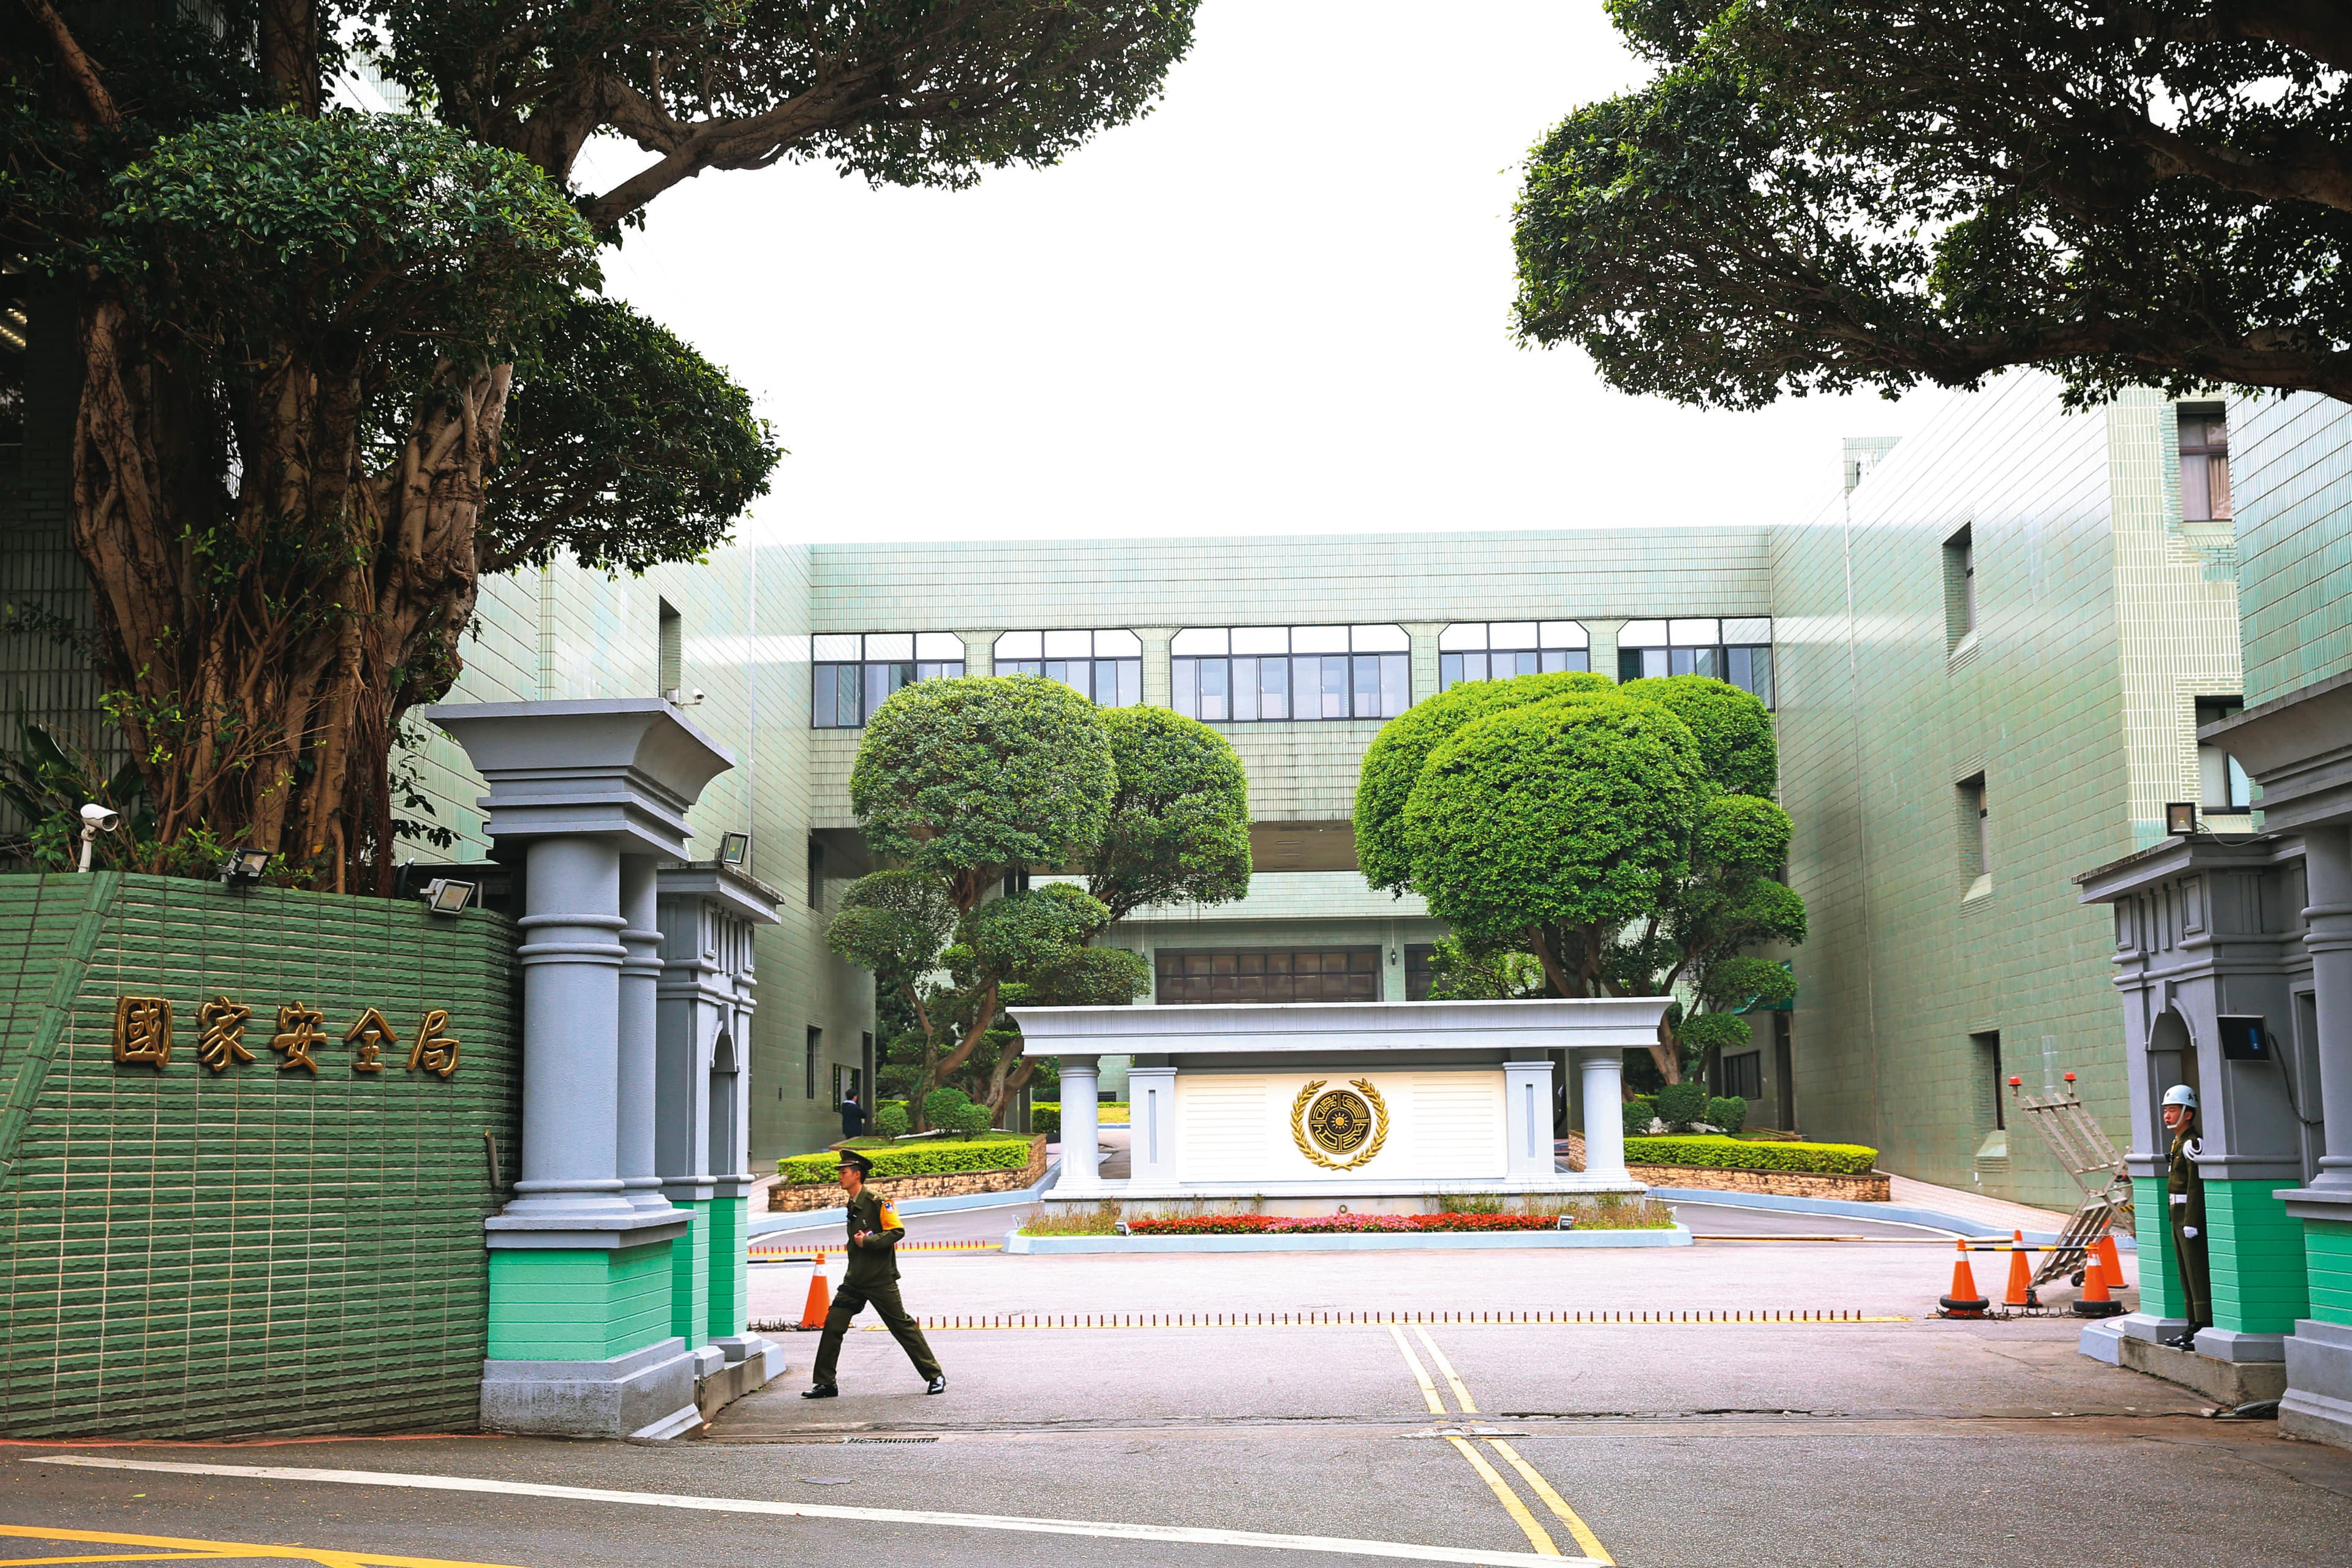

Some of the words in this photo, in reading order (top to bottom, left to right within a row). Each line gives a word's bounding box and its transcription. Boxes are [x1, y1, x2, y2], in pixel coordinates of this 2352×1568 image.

[116, 995, 460, 1077] 國家安全局
